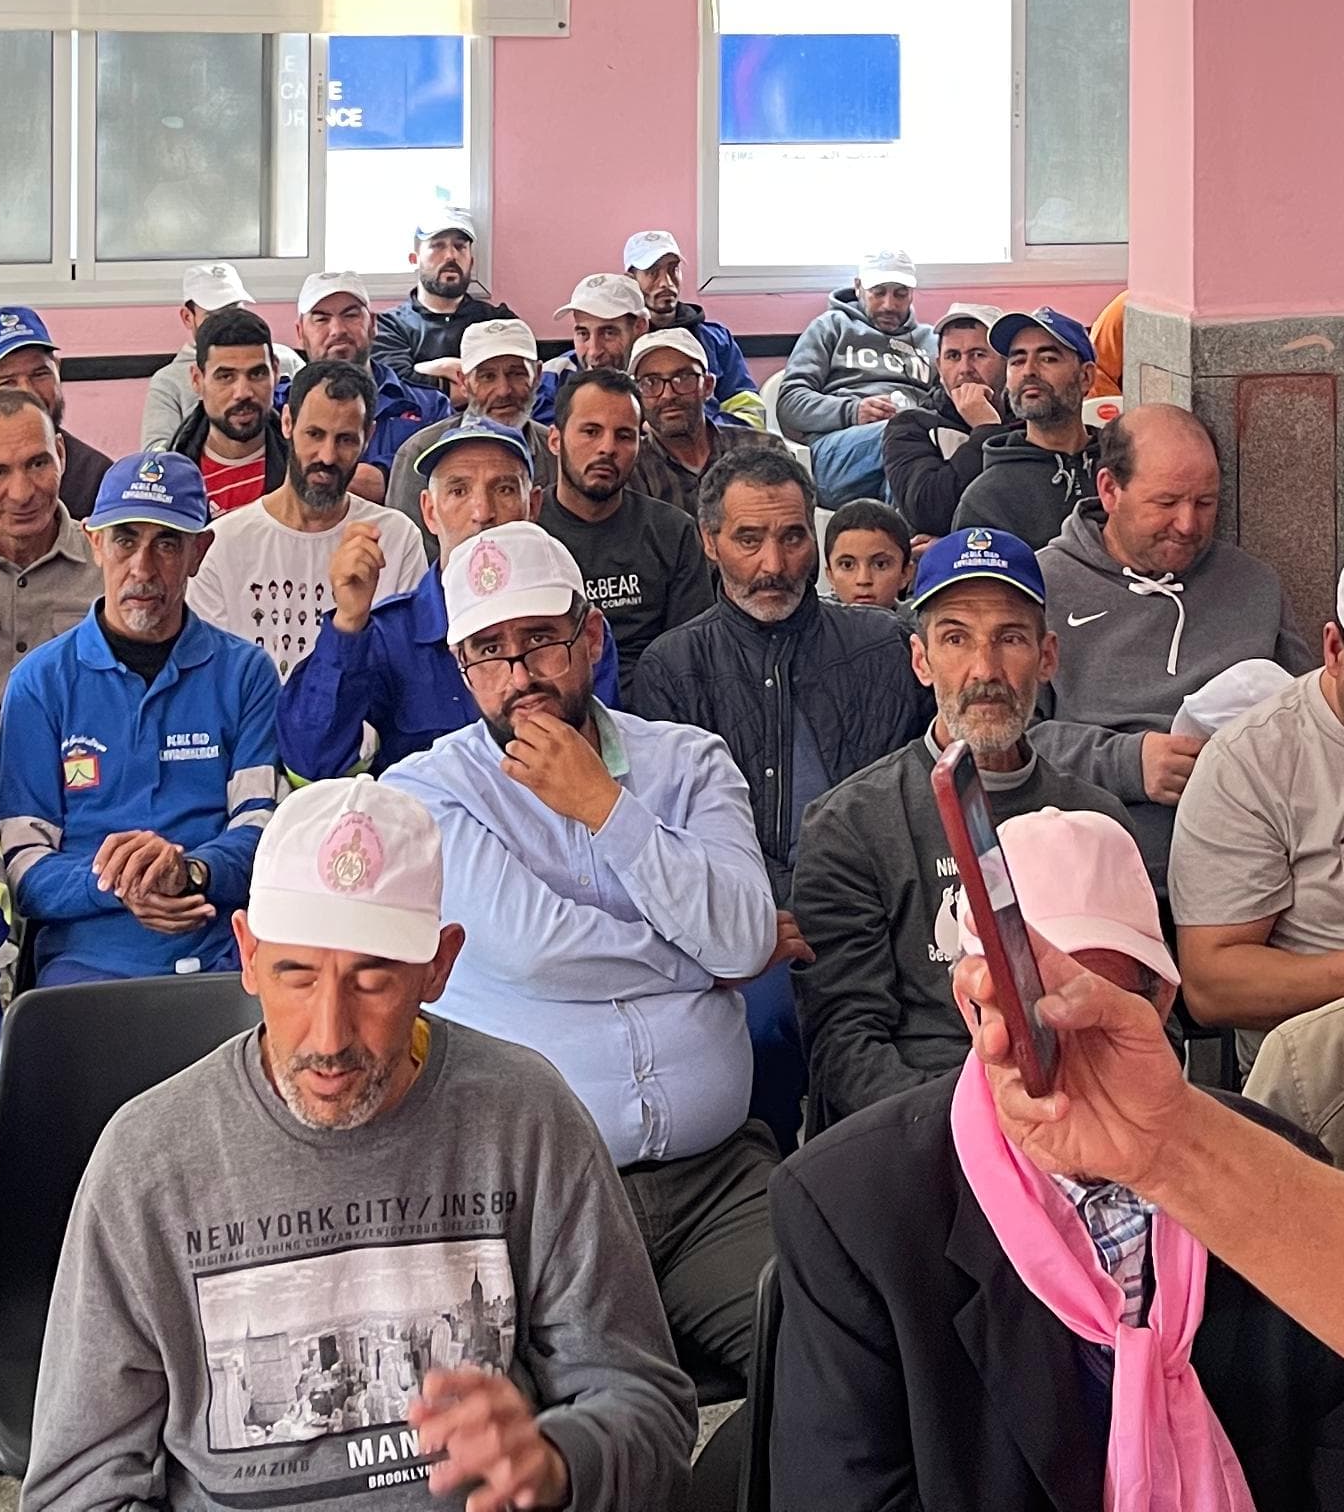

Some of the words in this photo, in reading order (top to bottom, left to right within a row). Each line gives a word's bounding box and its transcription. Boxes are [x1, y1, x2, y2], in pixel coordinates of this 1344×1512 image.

[846, 345, 930, 384] ICON
[186, 1221, 245, 1255] NEW
[257, 1206, 334, 1240] YORK
[346, 1197, 412, 1225] CITY
[233, 1458, 311, 1480] AMAZING
